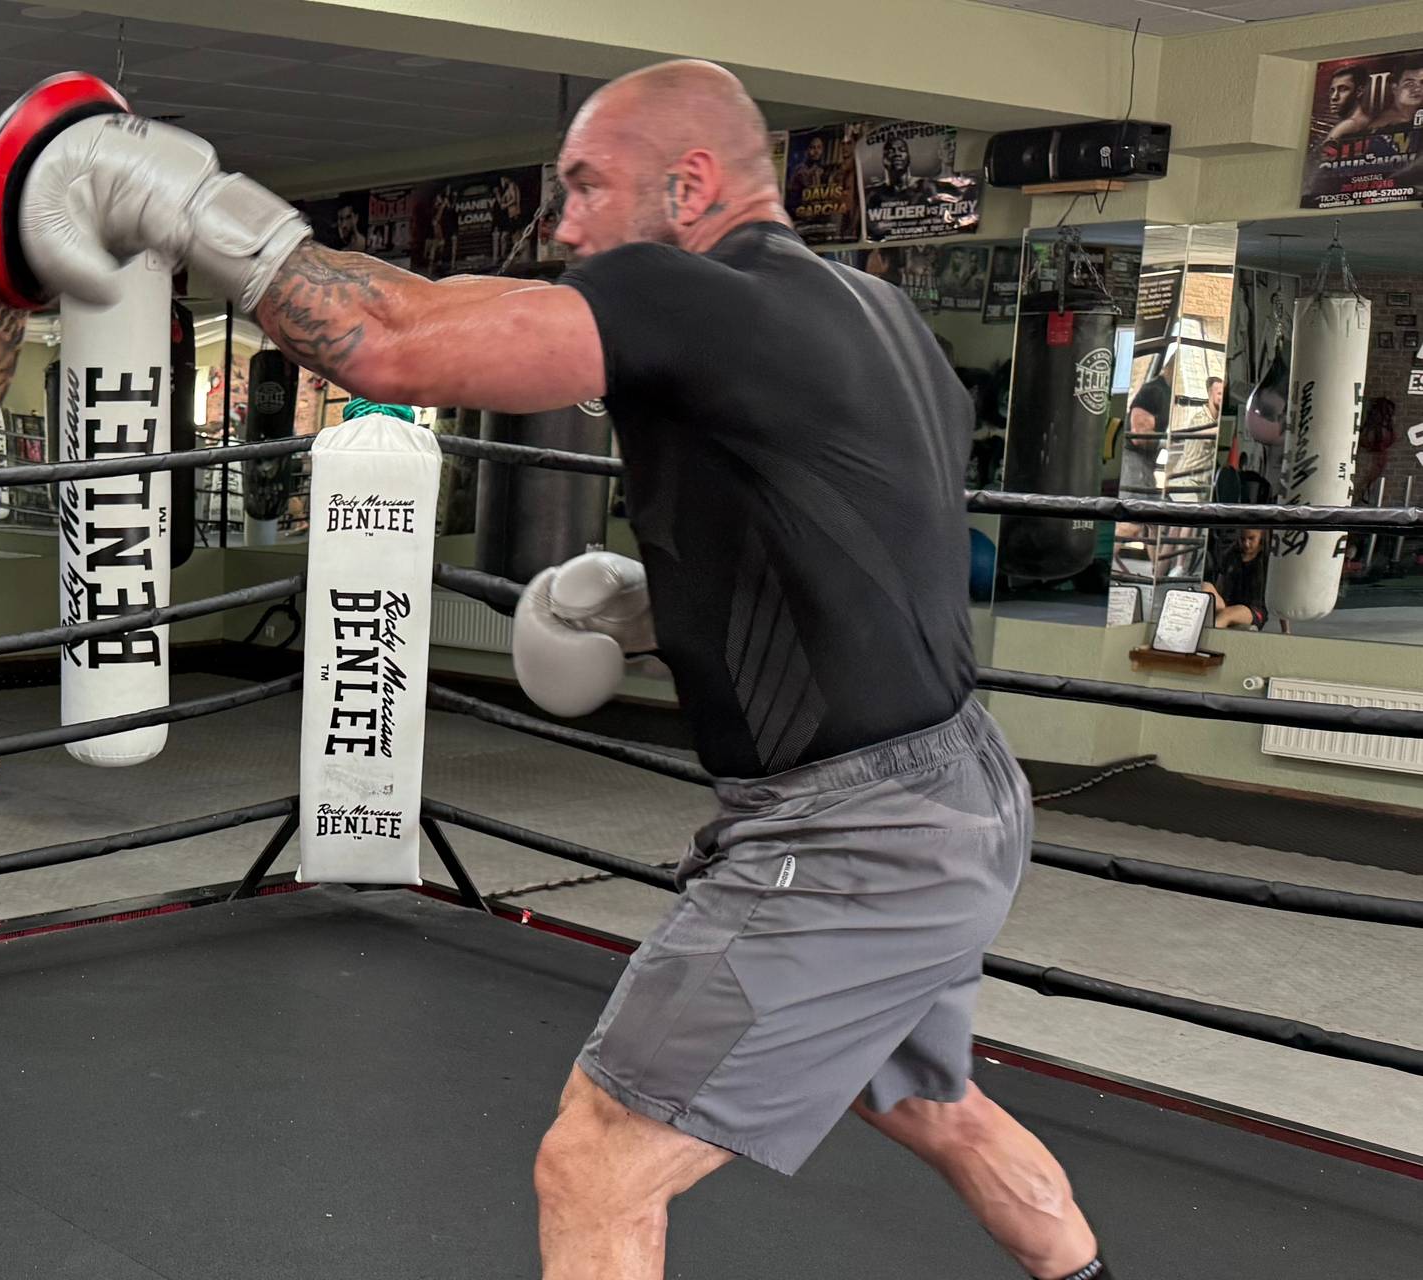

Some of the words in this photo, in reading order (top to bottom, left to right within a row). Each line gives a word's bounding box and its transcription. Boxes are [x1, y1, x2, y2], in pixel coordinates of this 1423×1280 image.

[801, 185, 844, 201] DAVIS
[458, 212, 493, 225] LOMA
[795, 203, 848, 217] GARCIA
[867, 205, 926, 221] WILDER
[938, 200, 978, 216] FURY
[59, 366, 82, 556] Maciano
[328, 493, 360, 509] Rocky
[362, 494, 415, 508] Marciano
[85, 365, 163, 670] BENLEE
[157, 506, 168, 538] TM
[326, 508, 415, 534] BENLEE
[380, 590, 412, 653] Rocky
[320, 663, 329, 682] TM
[324, 588, 383, 758] BENLEE
[380, 655, 408, 759] Marciano
[316, 802, 348, 817] Rocky
[349, 804, 403, 818] Marciano
[316, 814, 402, 839] BENLEE
